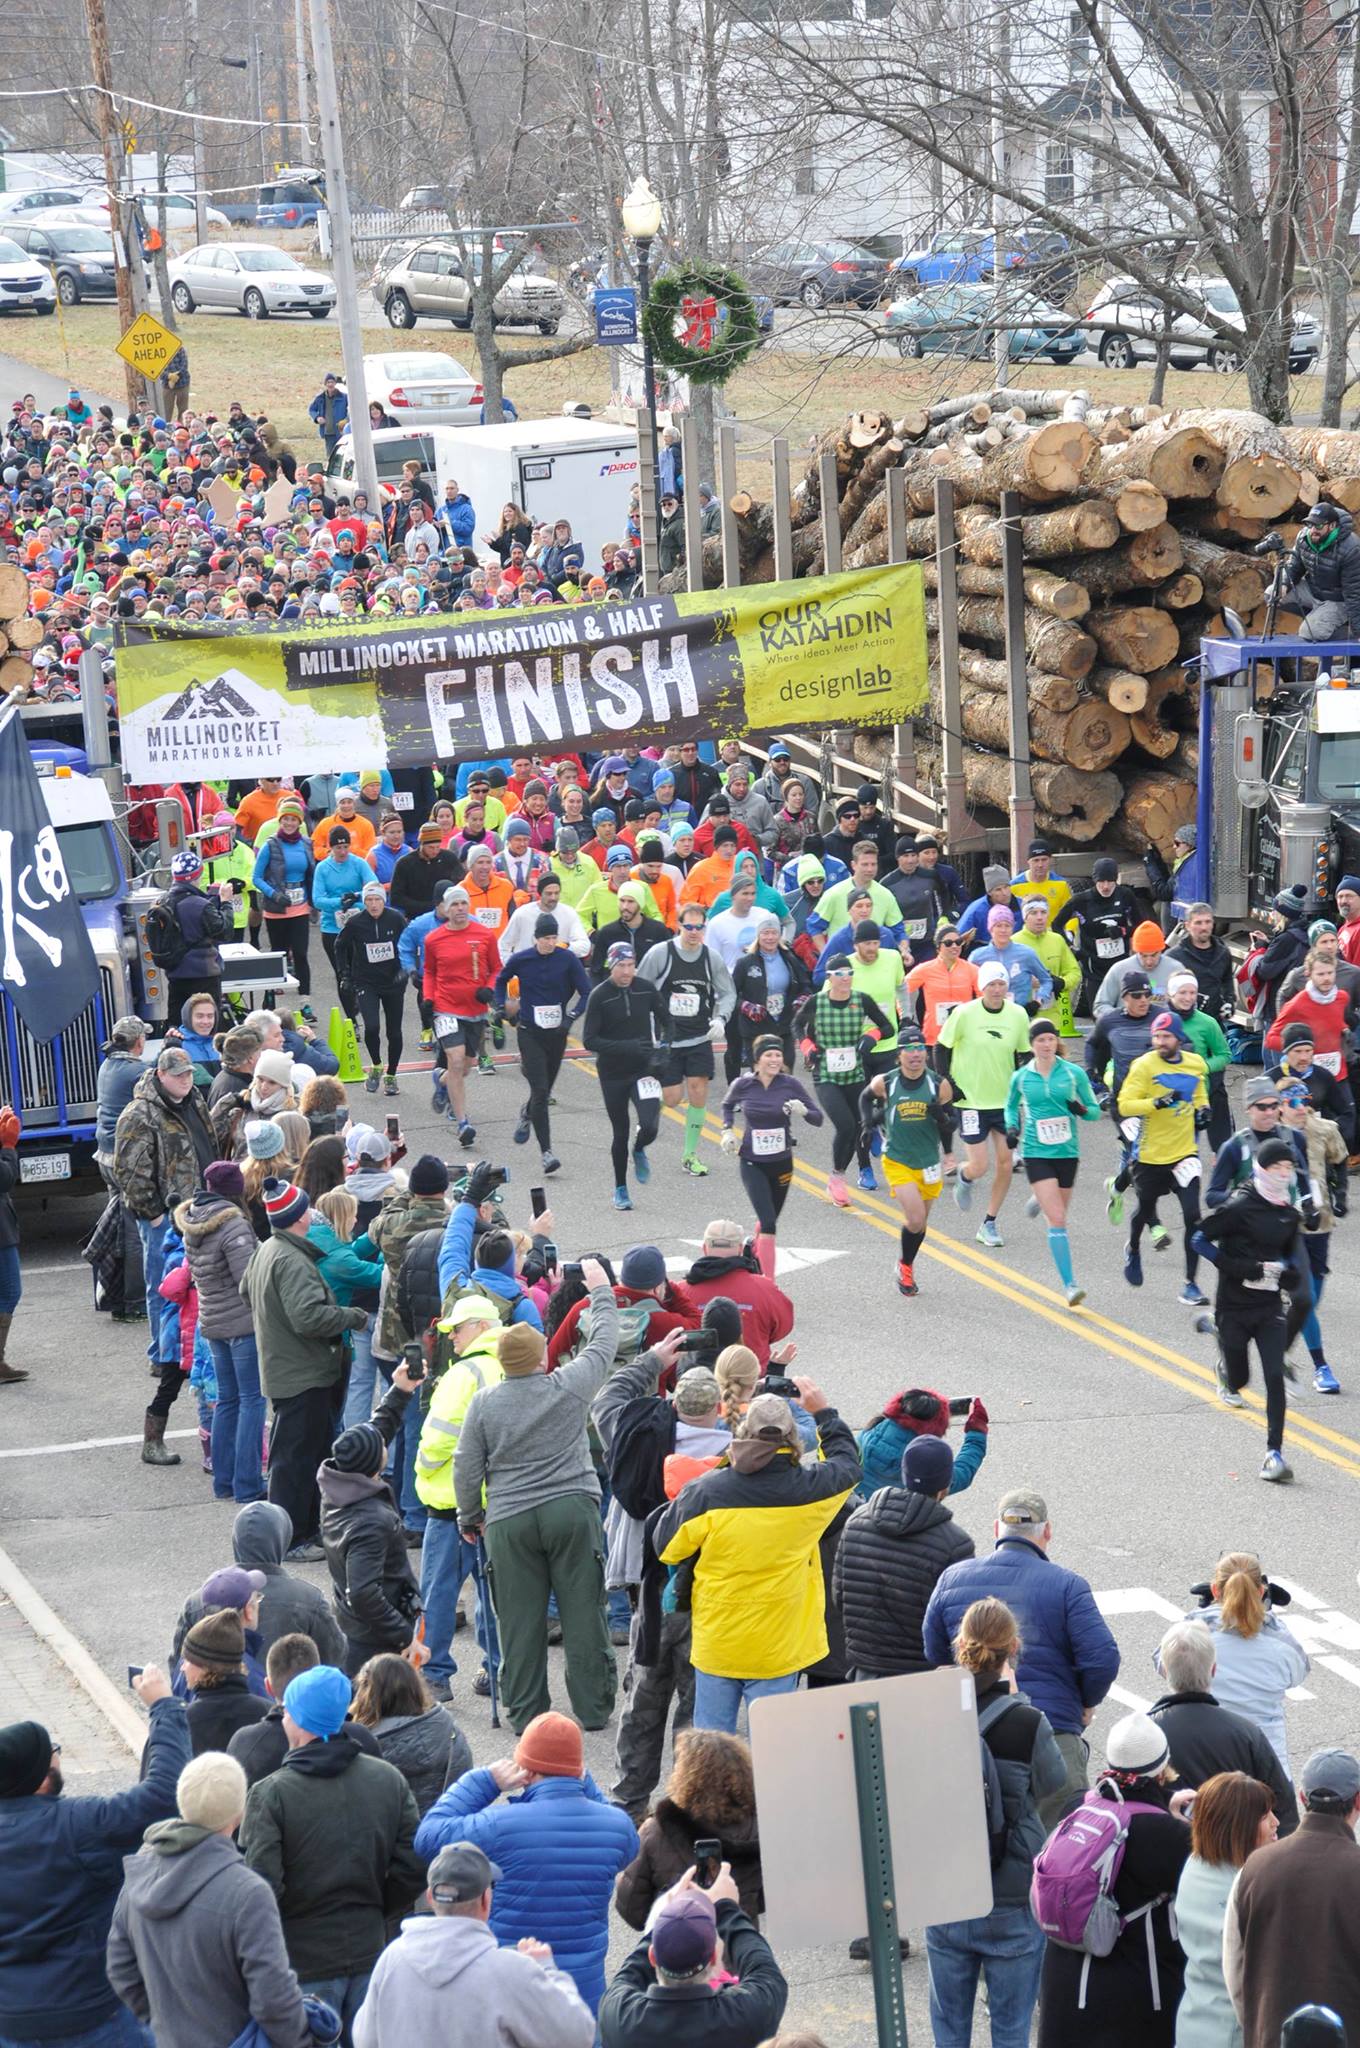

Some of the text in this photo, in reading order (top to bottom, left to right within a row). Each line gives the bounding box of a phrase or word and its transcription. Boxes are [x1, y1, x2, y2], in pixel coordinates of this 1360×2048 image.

[132, 332, 162, 346] STOP
[133, 347, 167, 361] AHEAD
[608, 462, 637, 475] pace
[758, 599, 824, 631] OUR
[299, 603, 664, 676] MILLINOCKET MARATHON & HALF
[759, 607, 893, 653] KATAHDIN
[766, 637, 896, 665] Where Ideas Meet Action
[780, 664, 893, 702] designlab
[424, 634, 699, 759] FINISH
[147, 721, 281, 747] MILLINOCKET
[480, 912, 497, 920] 403
[369, 945, 392, 956] 1644
[756, 1135, 783, 1144] 1476
